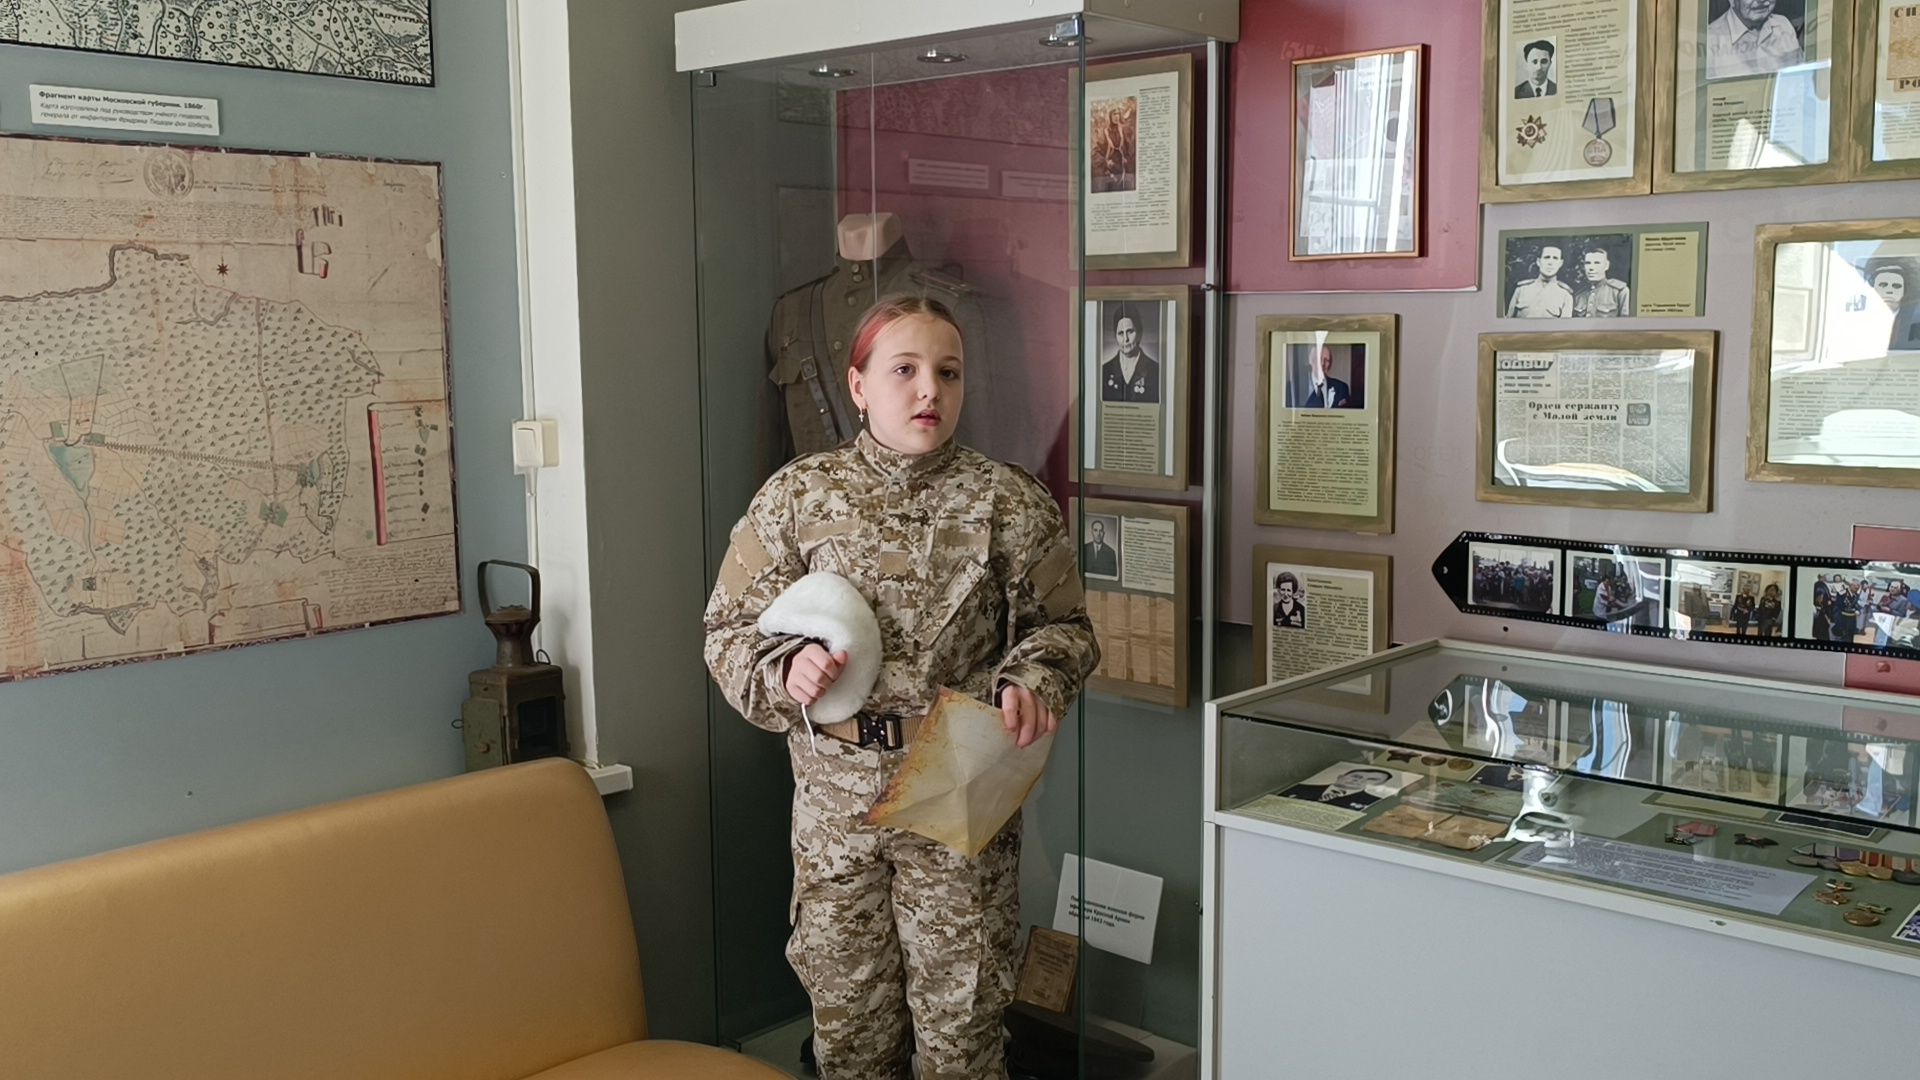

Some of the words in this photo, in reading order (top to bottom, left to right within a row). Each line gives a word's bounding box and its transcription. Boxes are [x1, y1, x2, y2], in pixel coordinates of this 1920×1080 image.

[38, 90, 76, 100] Фрагмент
[78, 94, 101, 102] карты
[102, 95, 146, 105] Московской
[40, 111, 70, 120] генерала
[1528, 401, 1561, 410] Орден
[1565, 402, 1620, 412] сержанту
[1544, 412, 1578, 420] Малой
